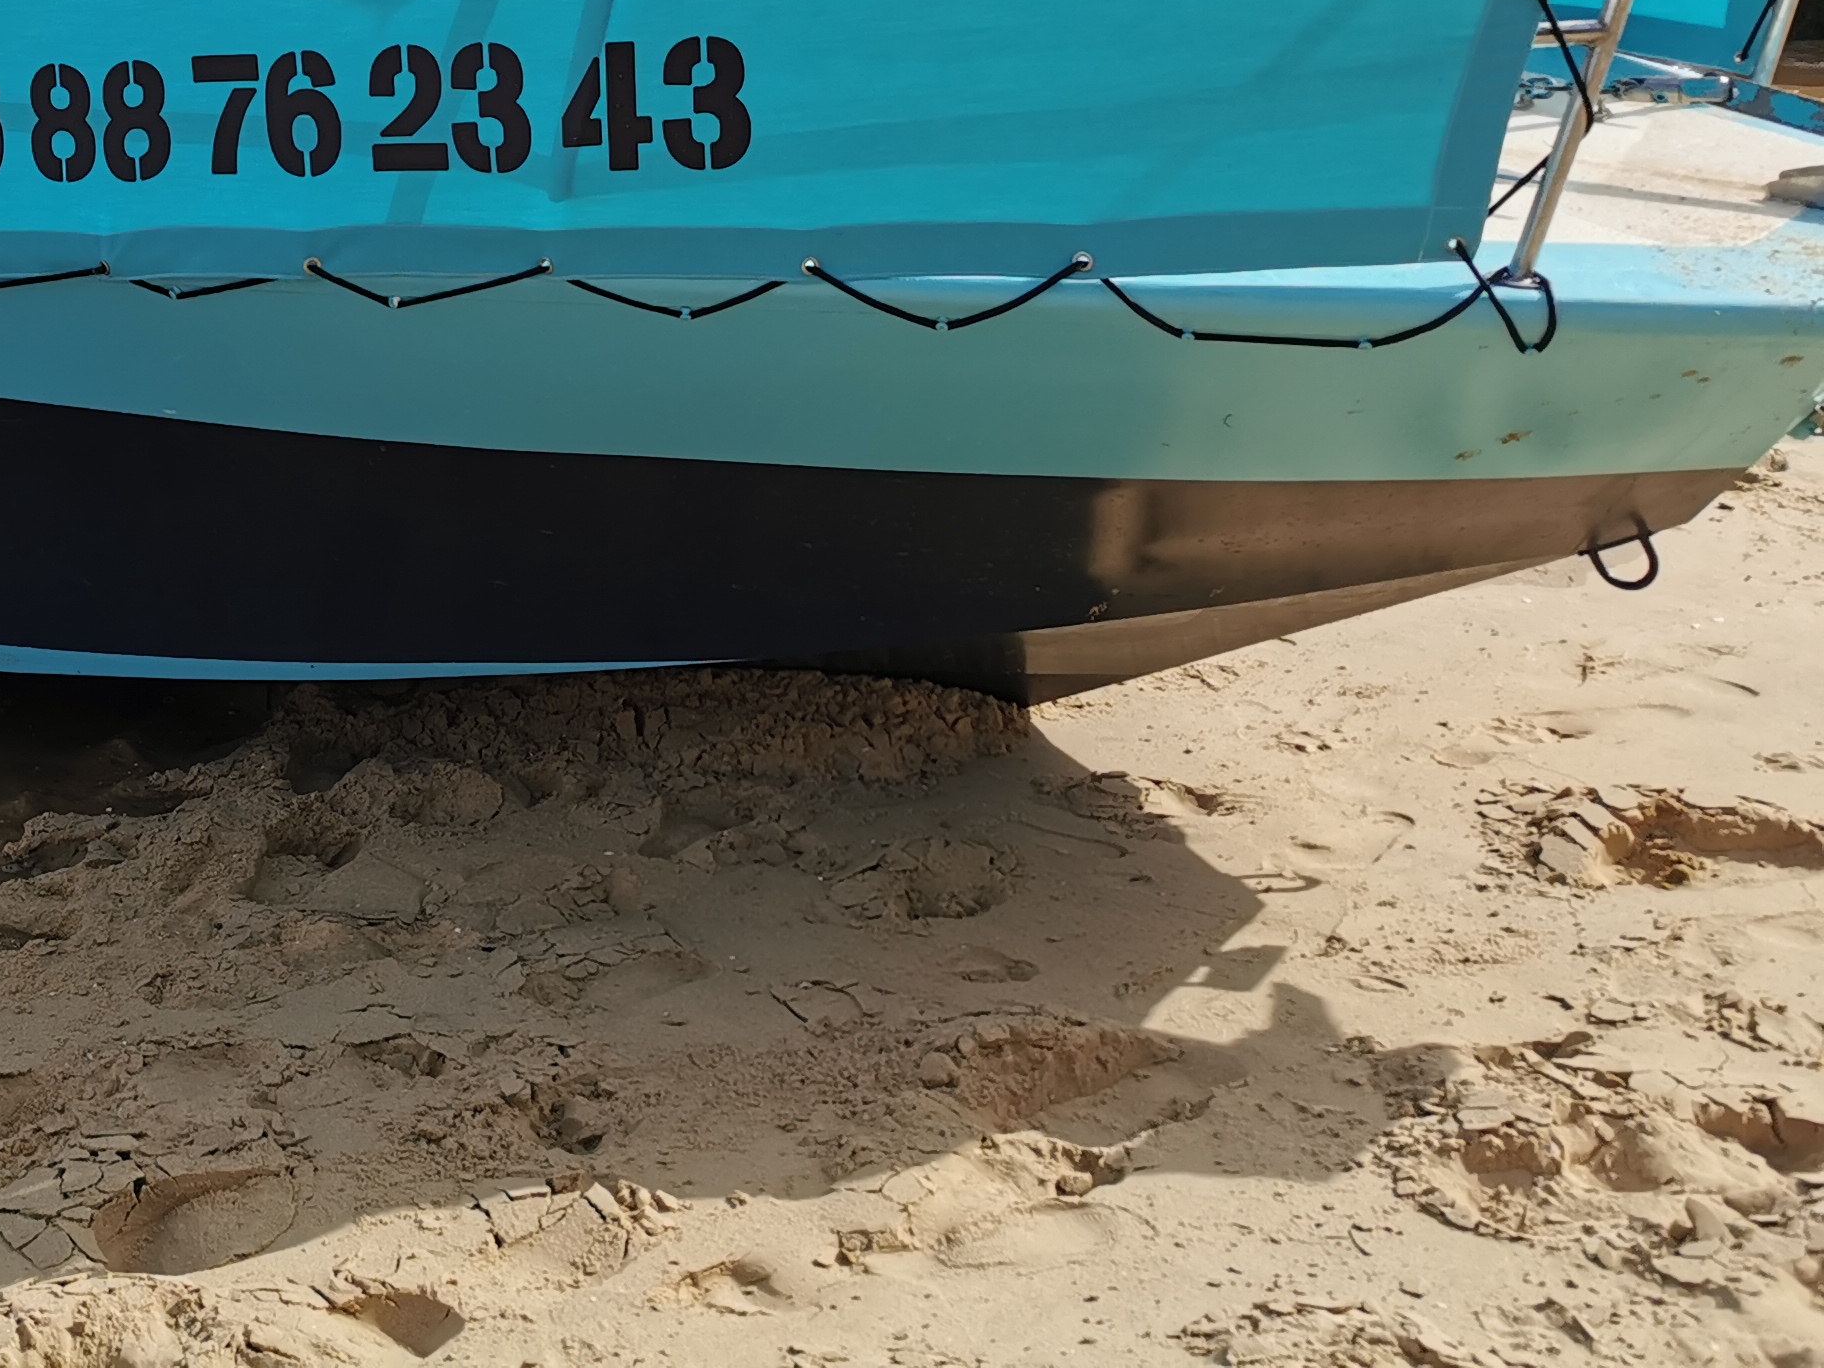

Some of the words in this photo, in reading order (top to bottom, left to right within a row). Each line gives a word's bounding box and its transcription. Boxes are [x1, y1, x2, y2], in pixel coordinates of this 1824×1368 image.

[29, 60, 172, 183] 88
[191, 50, 342, 178] 76
[368, 42, 532, 174] 23
[562, 36, 752, 172] 43
